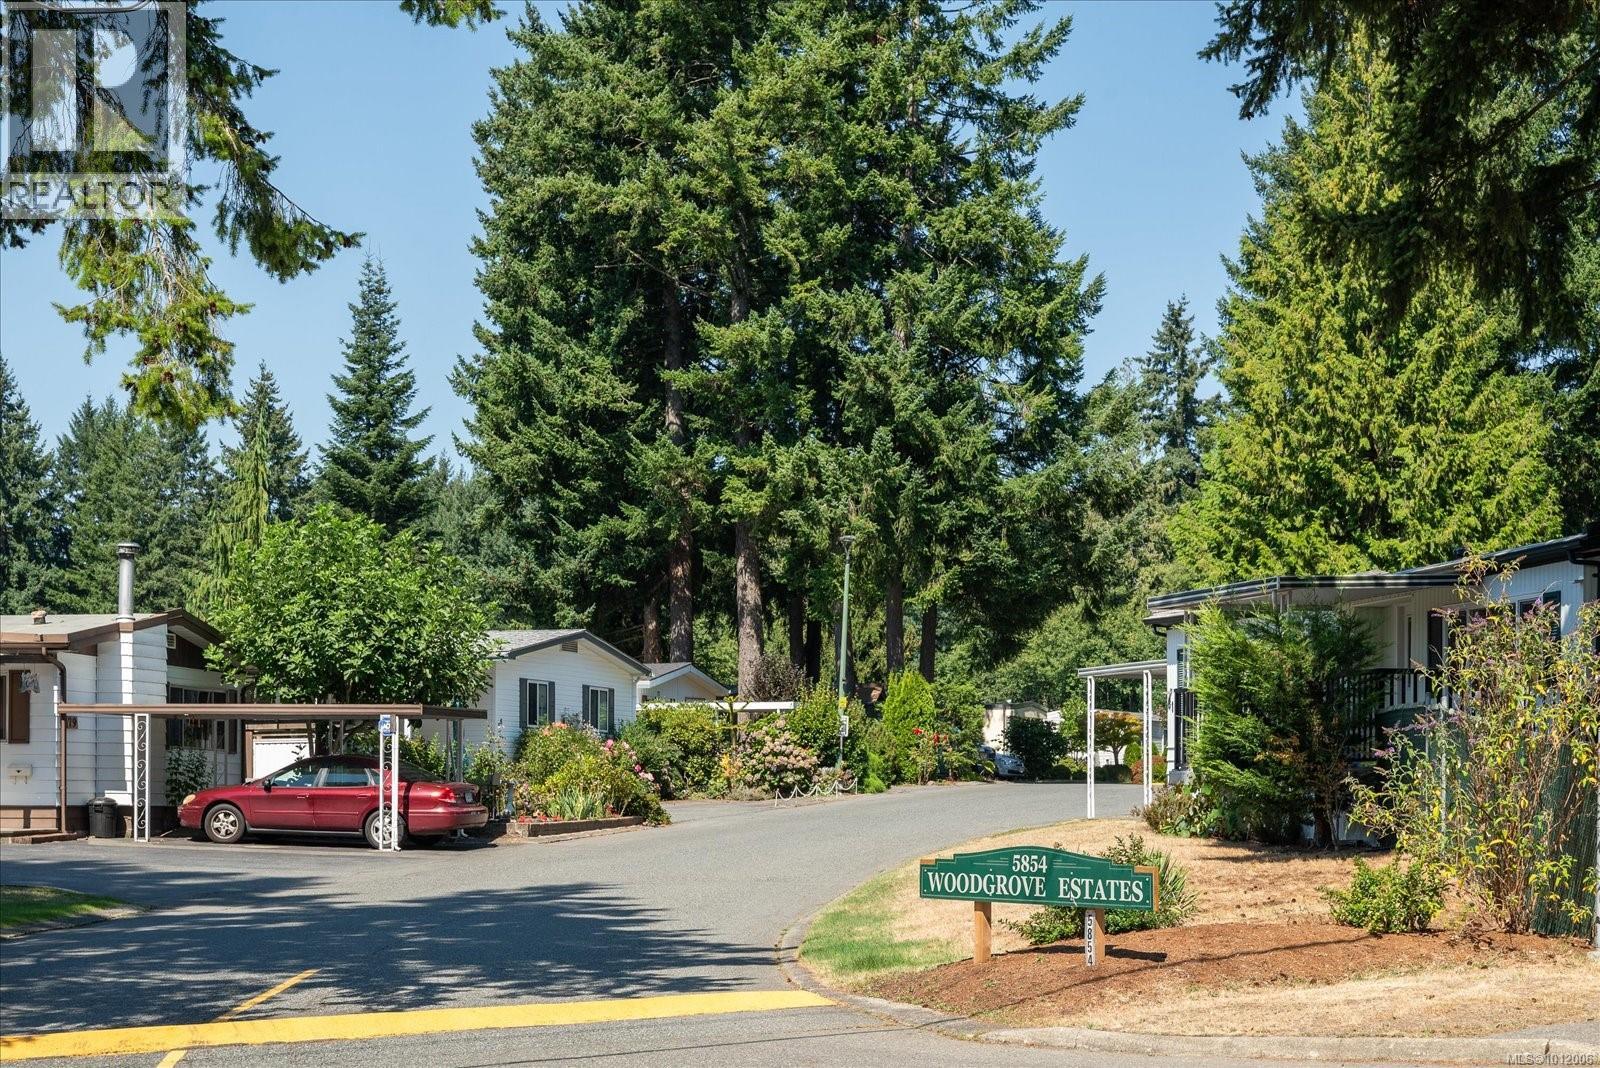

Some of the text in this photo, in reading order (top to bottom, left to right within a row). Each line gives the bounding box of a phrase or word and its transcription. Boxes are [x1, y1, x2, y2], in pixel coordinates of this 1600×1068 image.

[1012, 854, 1047, 873] 5854
[927, 871, 1144, 902] WOODGROVE ESTATES
